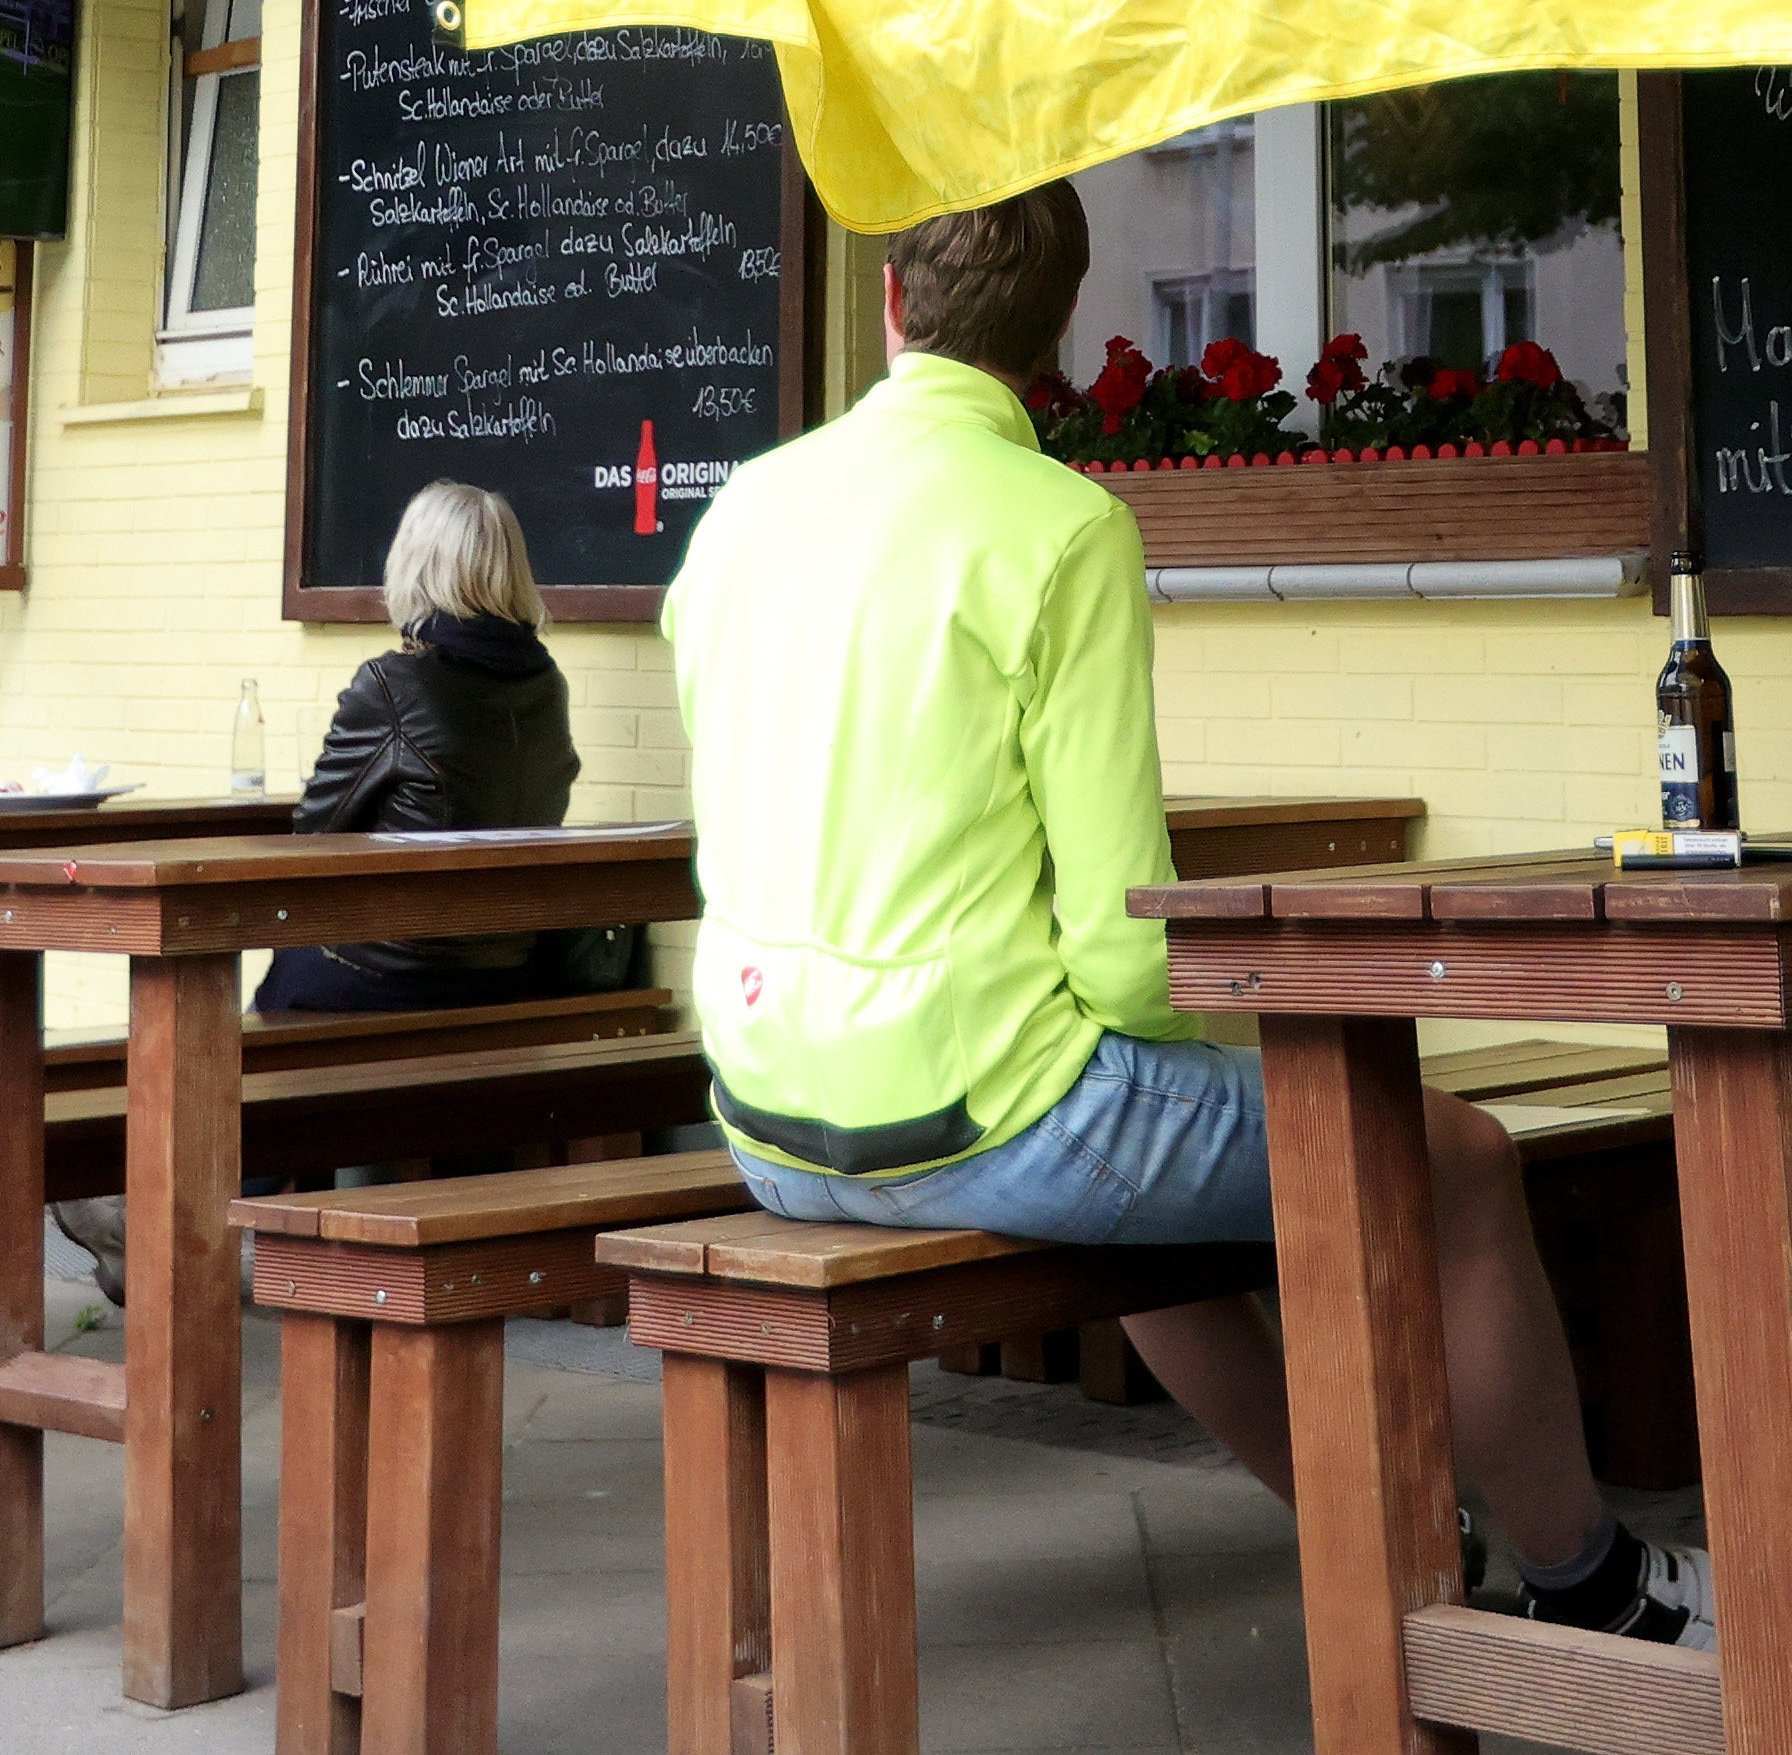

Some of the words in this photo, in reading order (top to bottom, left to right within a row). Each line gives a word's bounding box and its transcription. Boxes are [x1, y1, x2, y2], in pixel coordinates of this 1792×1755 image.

[518, 81, 552, 112] oder
[435, 142, 489, 187] Wiener
[495, 130, 525, 173] Art
[535, 127, 564, 173] mit
[655, 124, 709, 162] dazu
[517, 182, 610, 220] Hollandaise
[420, 242, 457, 280] mit
[560, 225, 614, 257] dazu
[621, 210, 737, 263] Salzkartoffeln
[604, 260, 658, 299] Butter
[358, 357, 450, 401] Schlemmer
[453, 353, 513, 411] Spargel
[518, 348, 550, 387] mit
[582, 339, 684, 376] Hollandaise
[397, 408, 446, 440] dazu
[447, 395, 558, 446] Salzkartoffeln
[691, 385, 758, 423] 13,50€
[594, 464, 633, 489] DAS
[661, 461, 739, 486] ORIGIN
